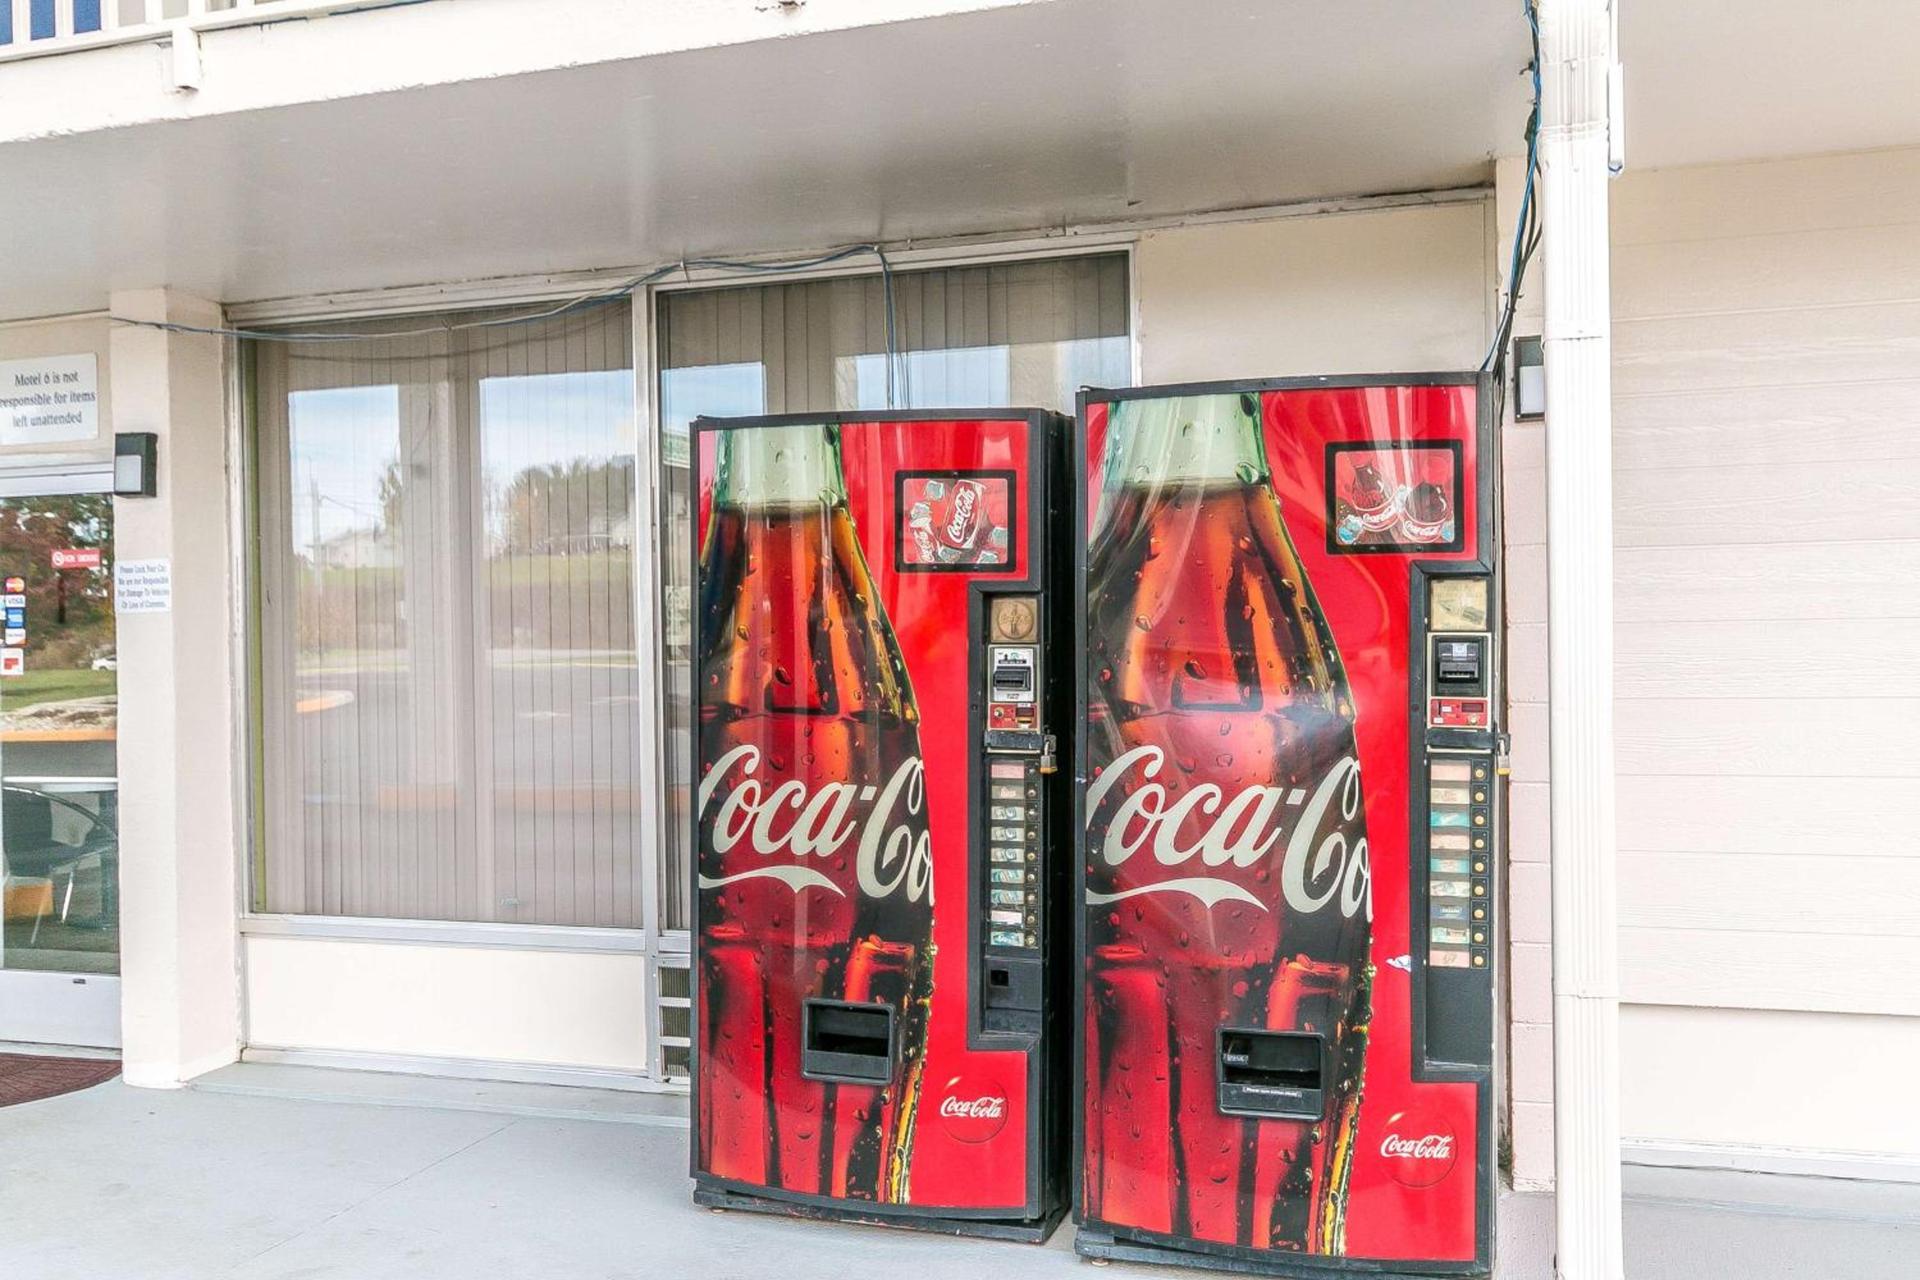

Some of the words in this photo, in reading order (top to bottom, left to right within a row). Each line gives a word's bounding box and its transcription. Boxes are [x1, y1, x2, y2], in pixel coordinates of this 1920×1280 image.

[14, 372, 41, 387] Motel
[43, 372, 50, 385] 6
[52, 370, 61, 385] is
[62, 371, 80, 385] not
[53, 391, 68, 405] for
[69, 391, 96, 403] items
[12, 414, 28, 429] left
[30, 411, 83, 427] unattended
